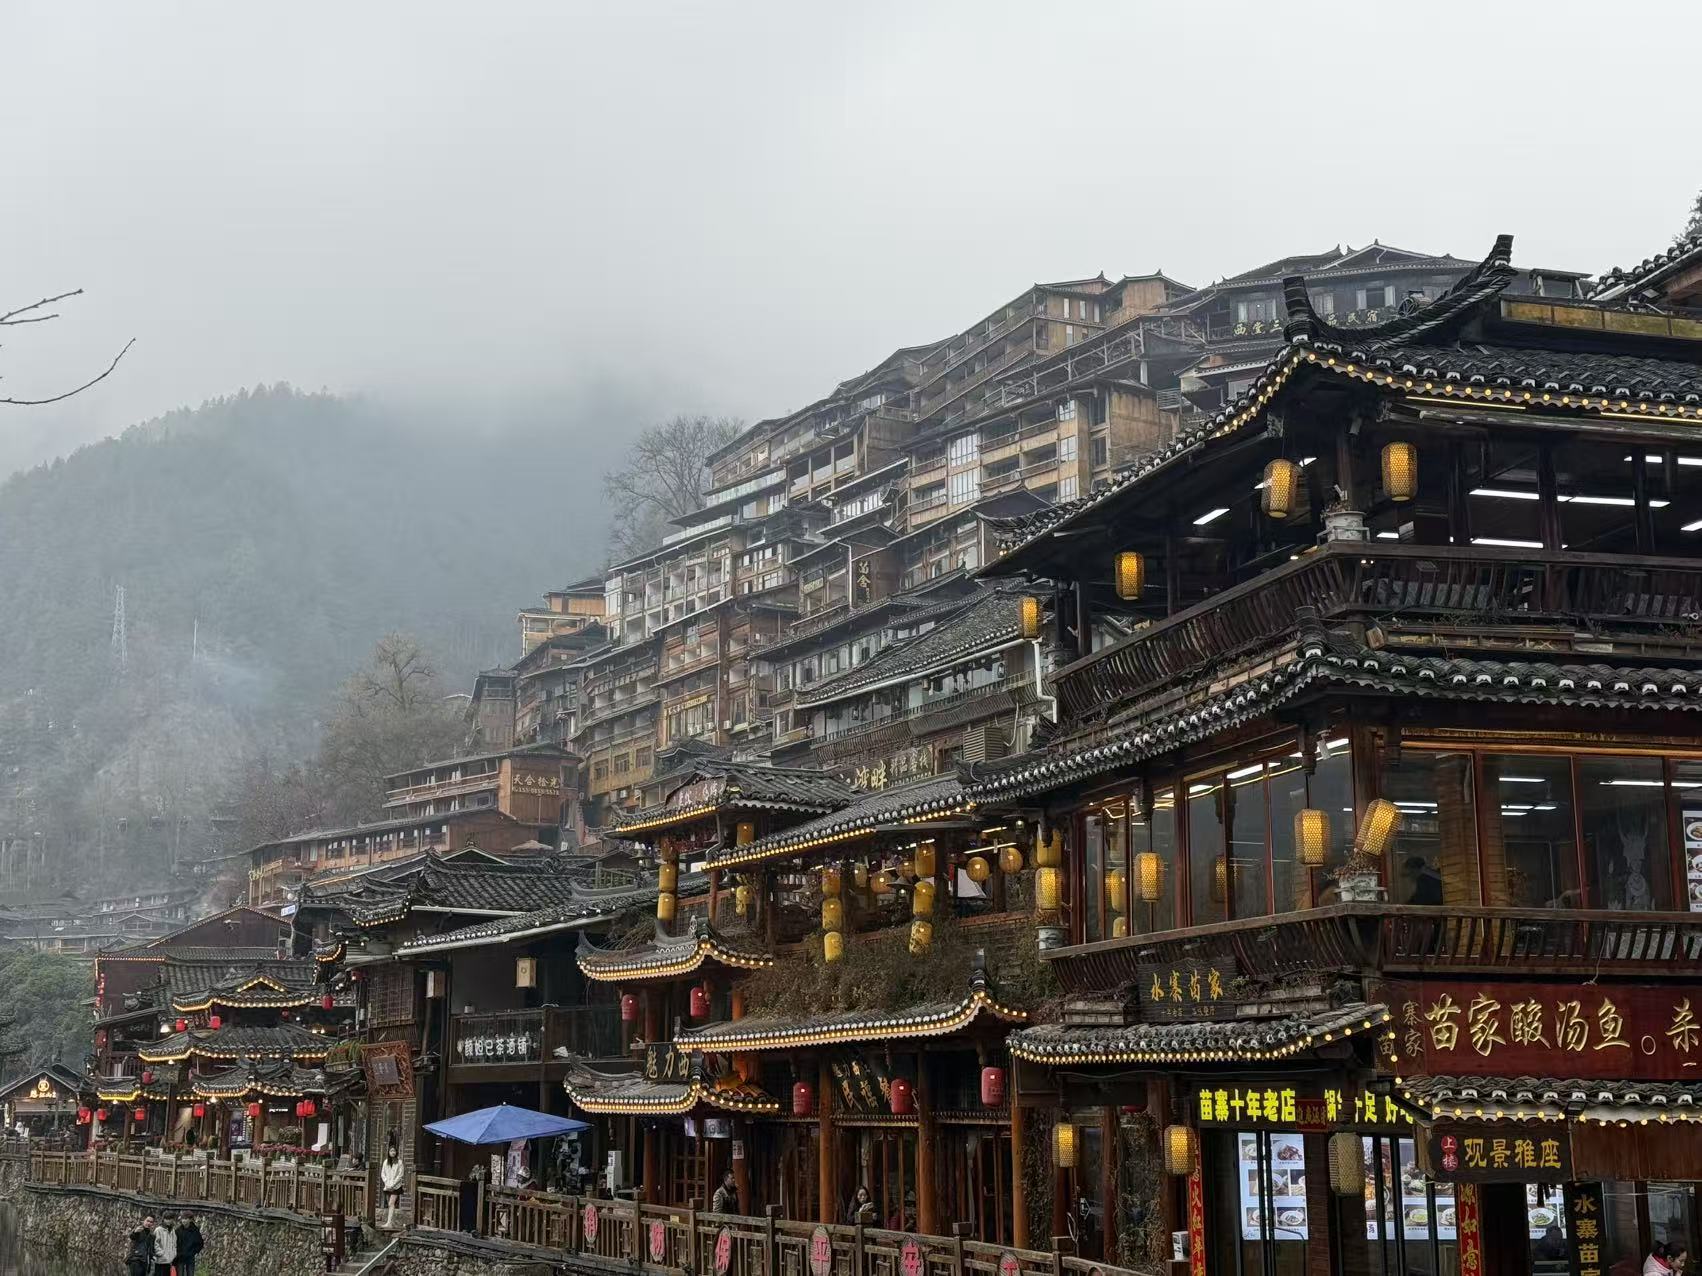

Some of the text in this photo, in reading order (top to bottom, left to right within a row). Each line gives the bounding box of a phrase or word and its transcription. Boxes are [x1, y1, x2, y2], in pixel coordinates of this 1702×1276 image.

[1424, 992, 1631, 1057] 苗家酸汤鱼
[1199, 1087, 1296, 1122] 苗寨十年老店
[1463, 1137, 1562, 1169] 观景雅座
